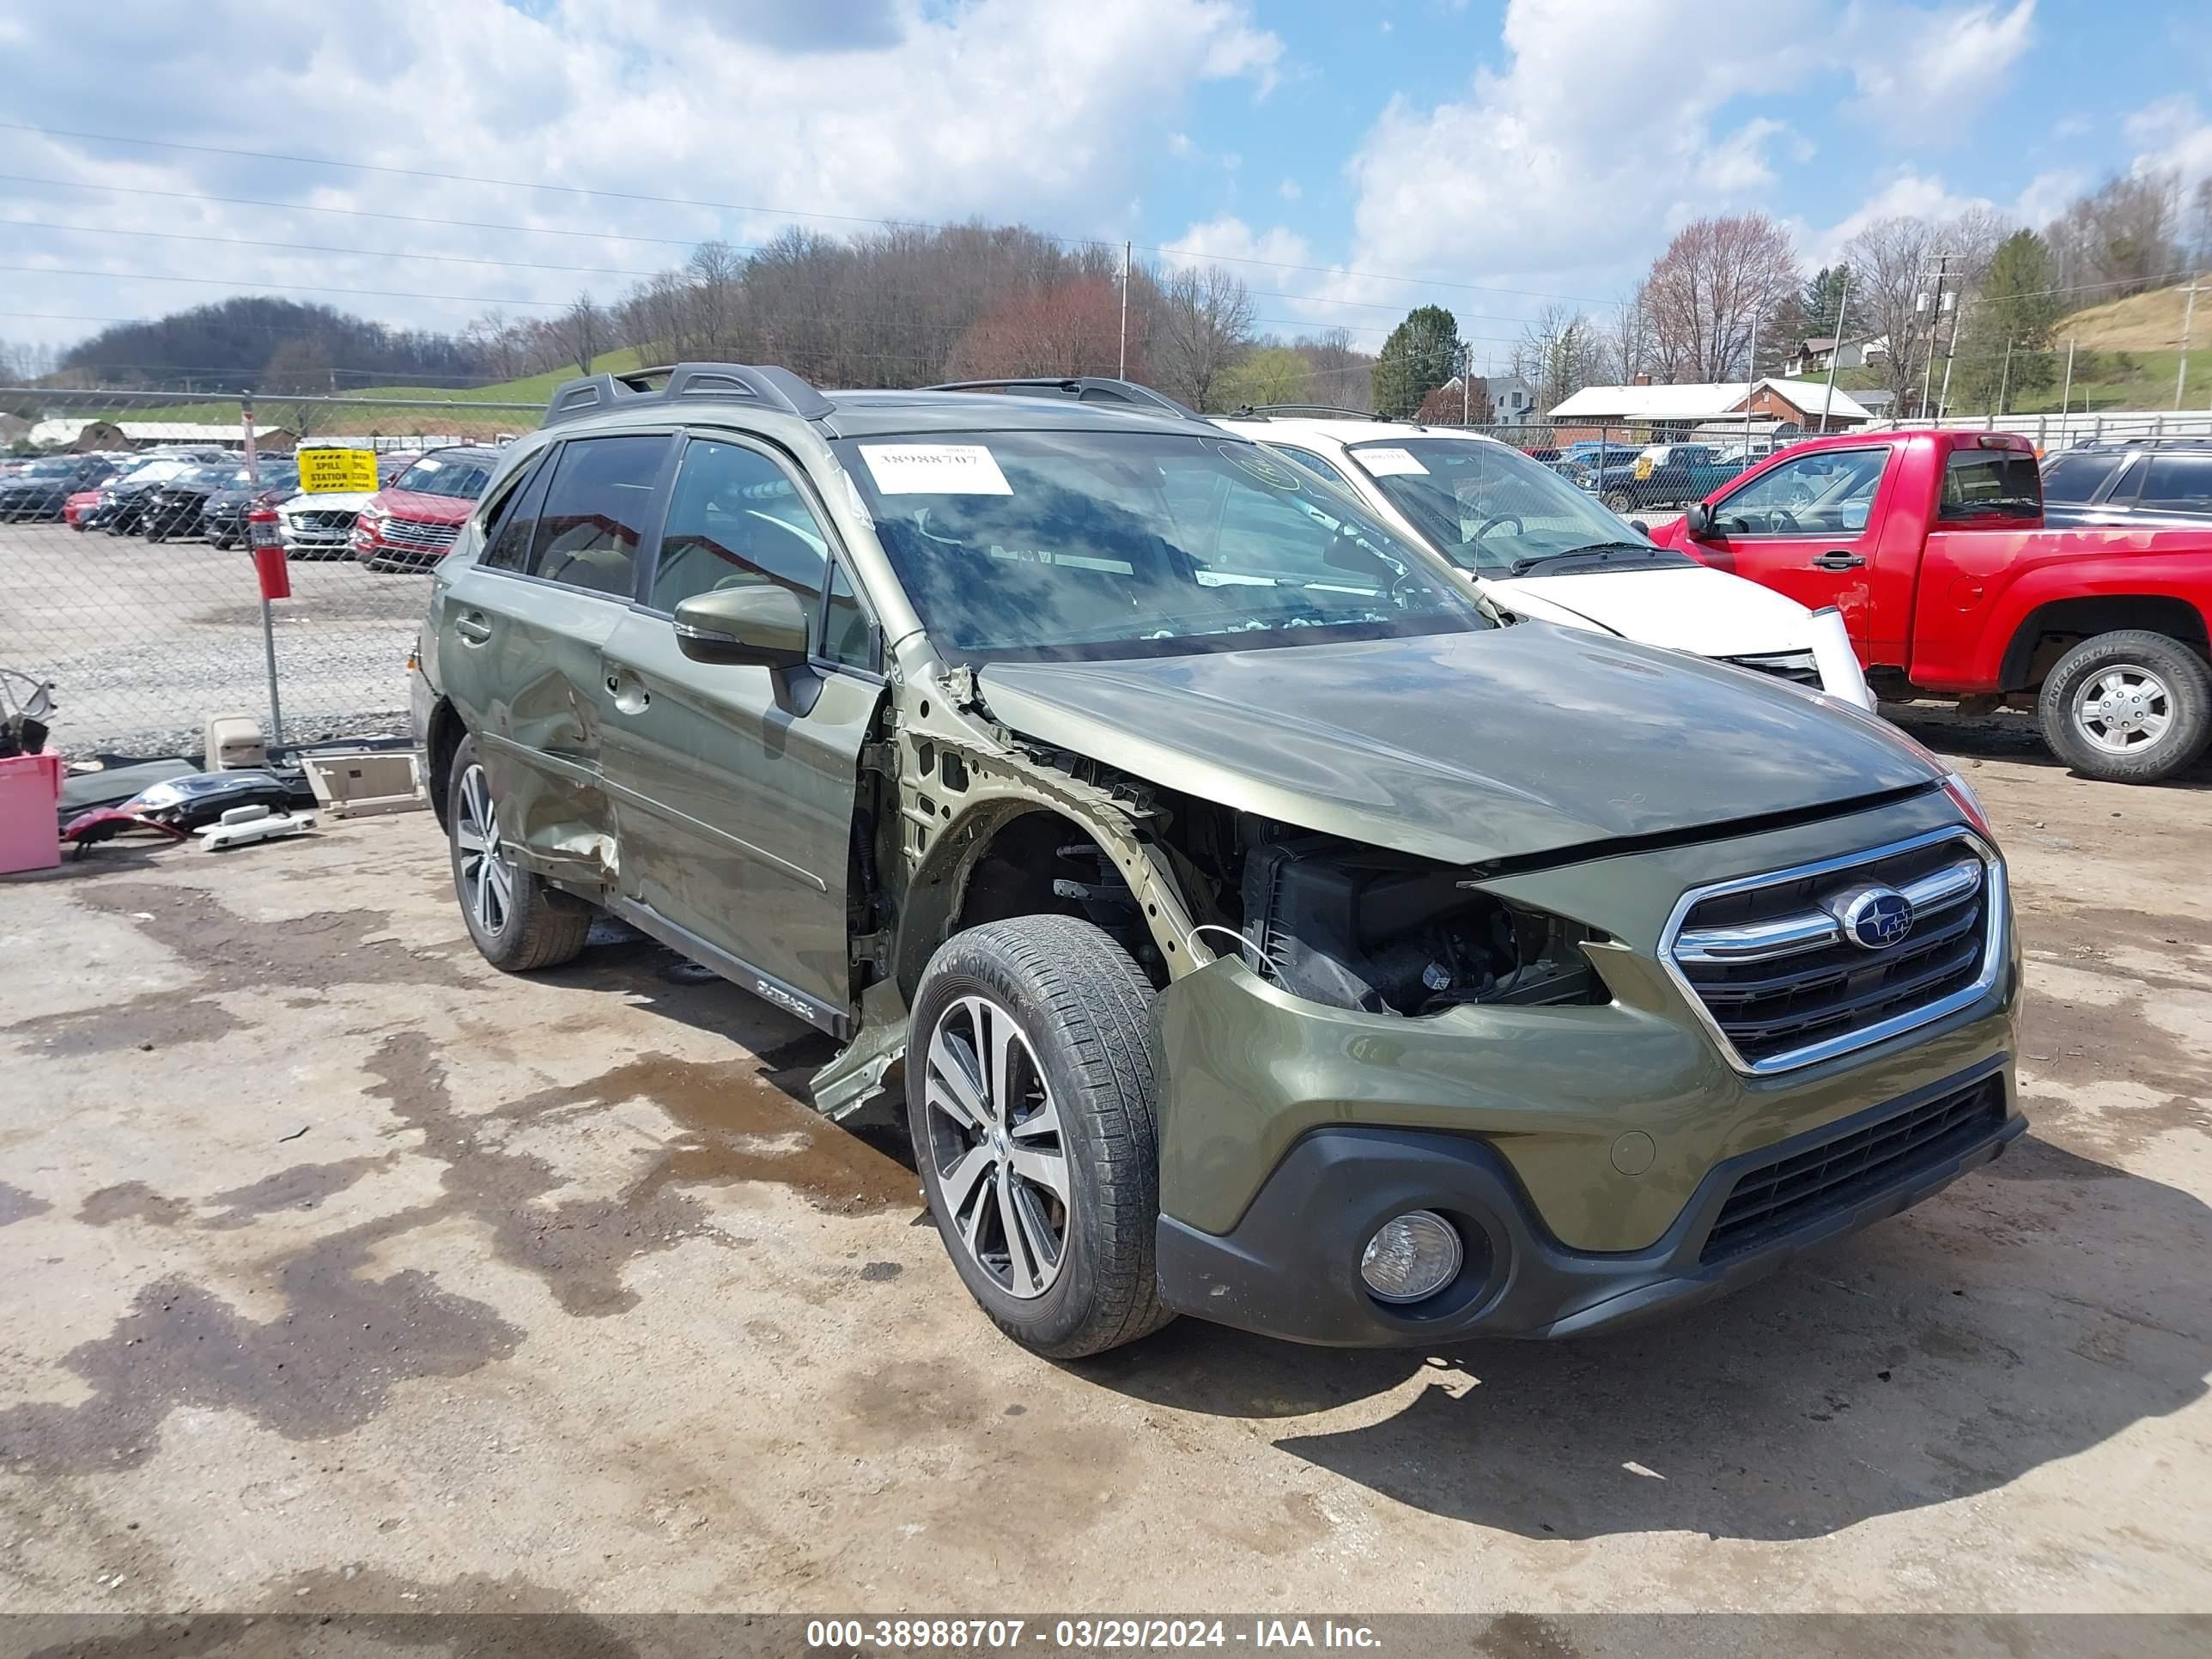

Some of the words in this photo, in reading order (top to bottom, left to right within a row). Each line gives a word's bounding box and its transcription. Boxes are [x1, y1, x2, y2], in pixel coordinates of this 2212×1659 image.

[310, 472, 348, 482] STATION
[2049, 654, 2090, 708] ENTRADA
[935, 952, 1019, 1012] YOKOHAMA
